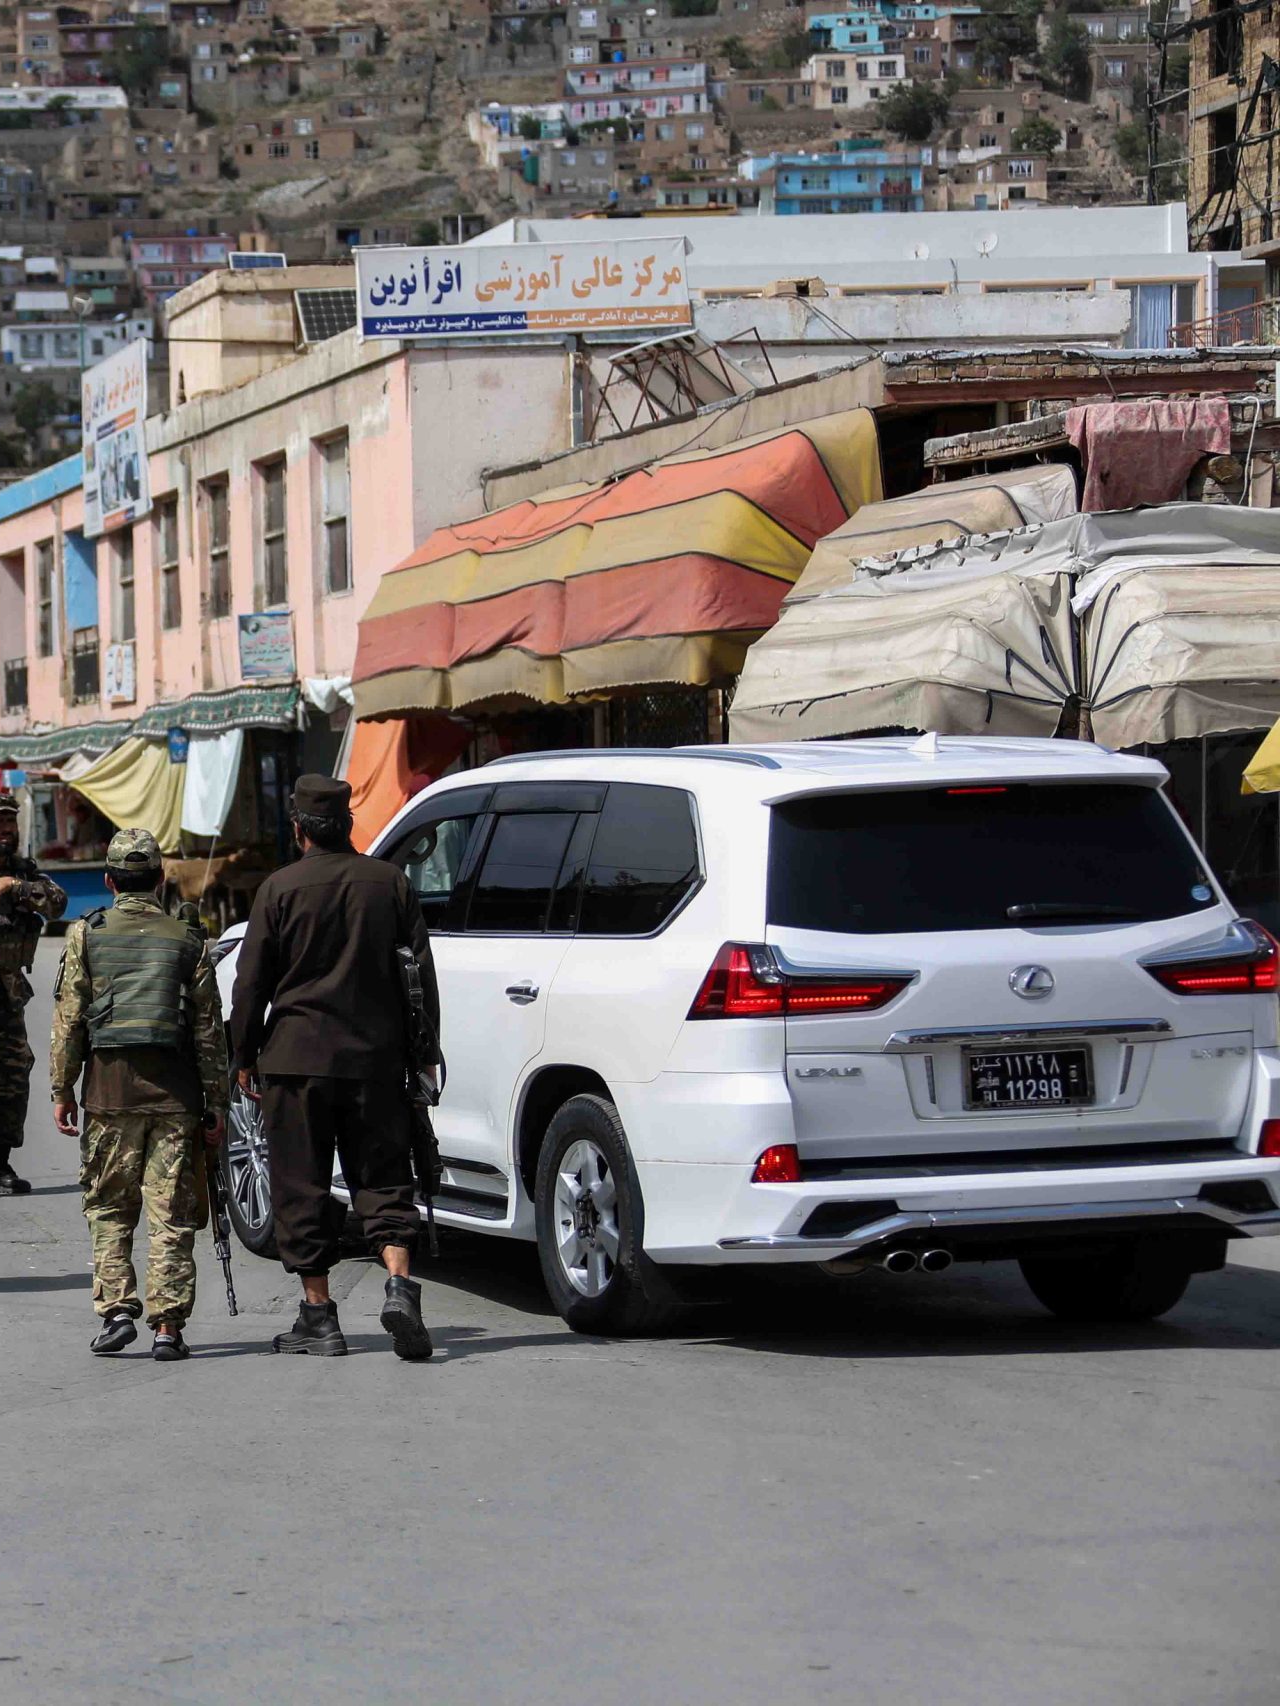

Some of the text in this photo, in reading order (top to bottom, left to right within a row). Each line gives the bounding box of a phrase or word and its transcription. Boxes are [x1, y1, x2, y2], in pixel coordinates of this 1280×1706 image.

[370, 263, 417, 306] نوین
[475, 254, 564, 302] آموزشی
[572, 256, 623, 299] عالی
[630, 255, 682, 297] مرکز
[650, 311, 669, 322] بخش
[794, 1067, 863, 1078] LEXUS
[972, 1056, 1001, 1072] کابل
[1006, 1078, 1063, 1101] 11298
